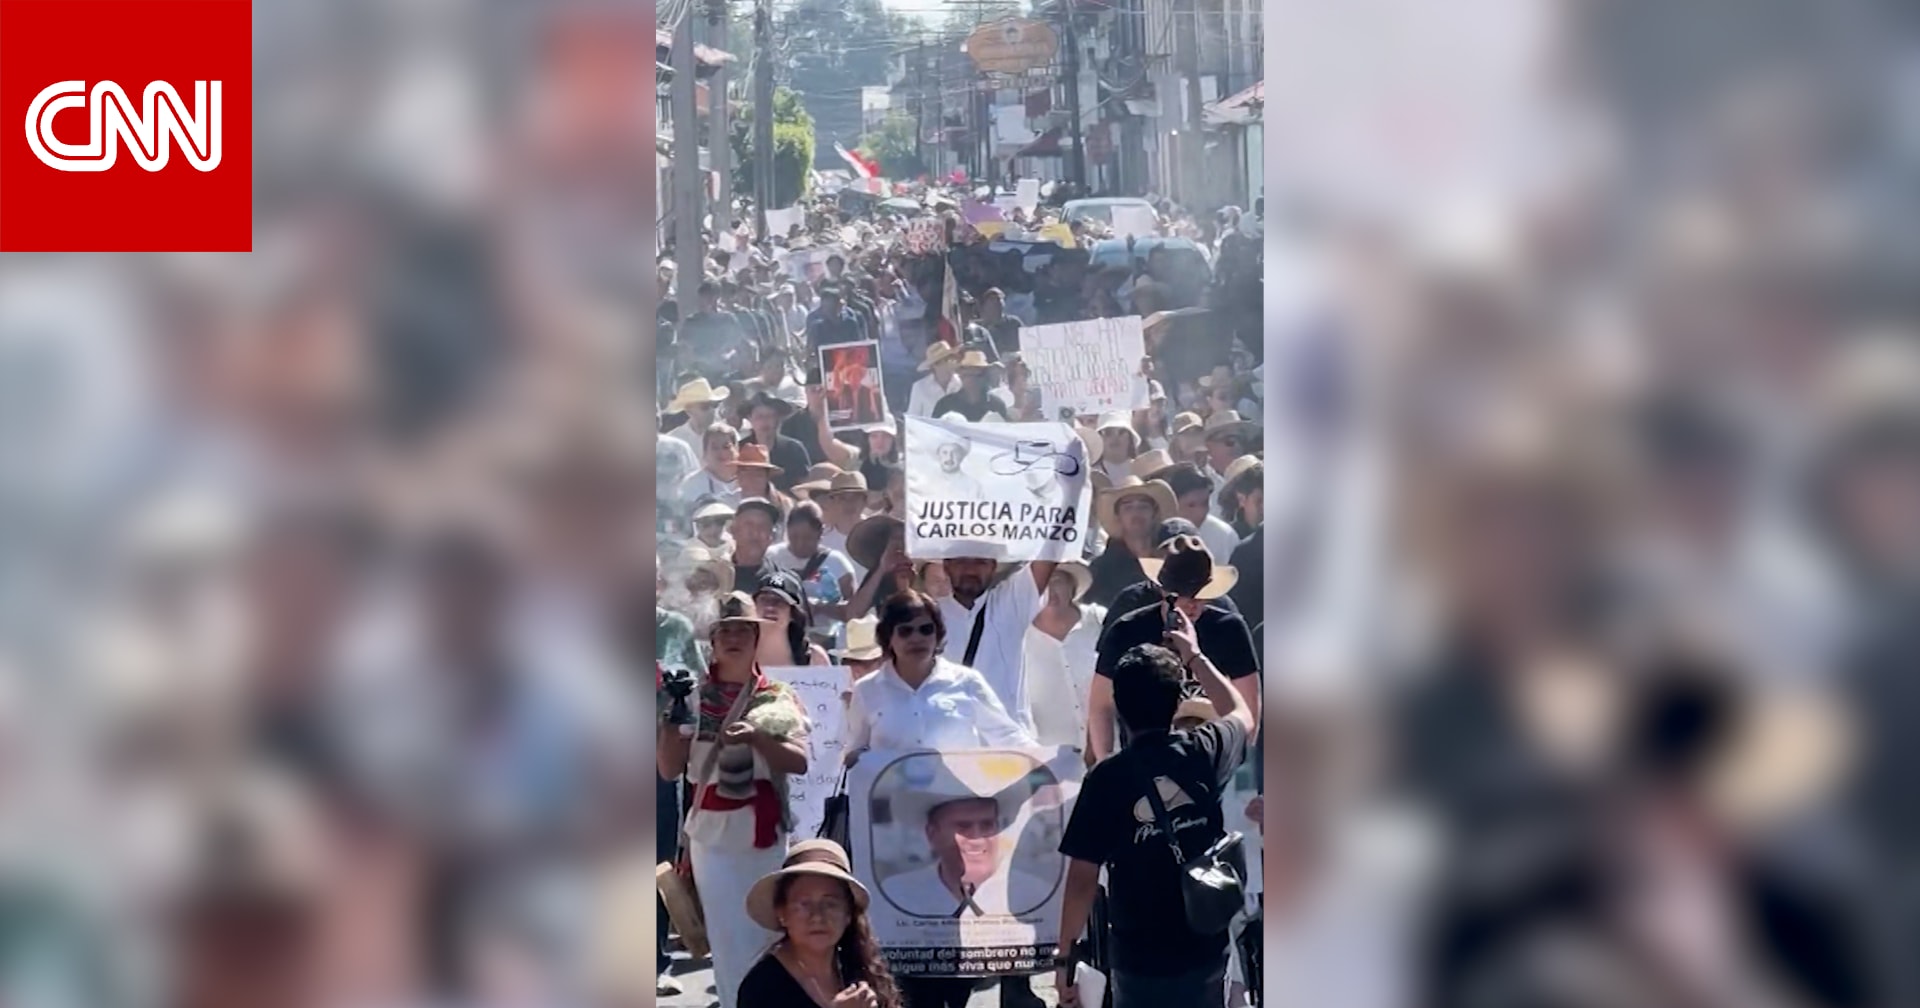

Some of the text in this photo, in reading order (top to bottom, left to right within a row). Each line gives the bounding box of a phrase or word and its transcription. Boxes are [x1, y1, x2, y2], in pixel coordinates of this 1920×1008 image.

[919, 501, 1077, 524] JUSTICIA PARA
[917, 521, 1077, 542] CARLOS MANZO
[937, 948, 956, 960] del
[960, 946, 1018, 960] sombrero
[1020, 945, 1037, 957] no
[958, 960, 985, 973] viva
[987, 960, 1013, 972] que
[1014, 959, 1055, 969] nunca
